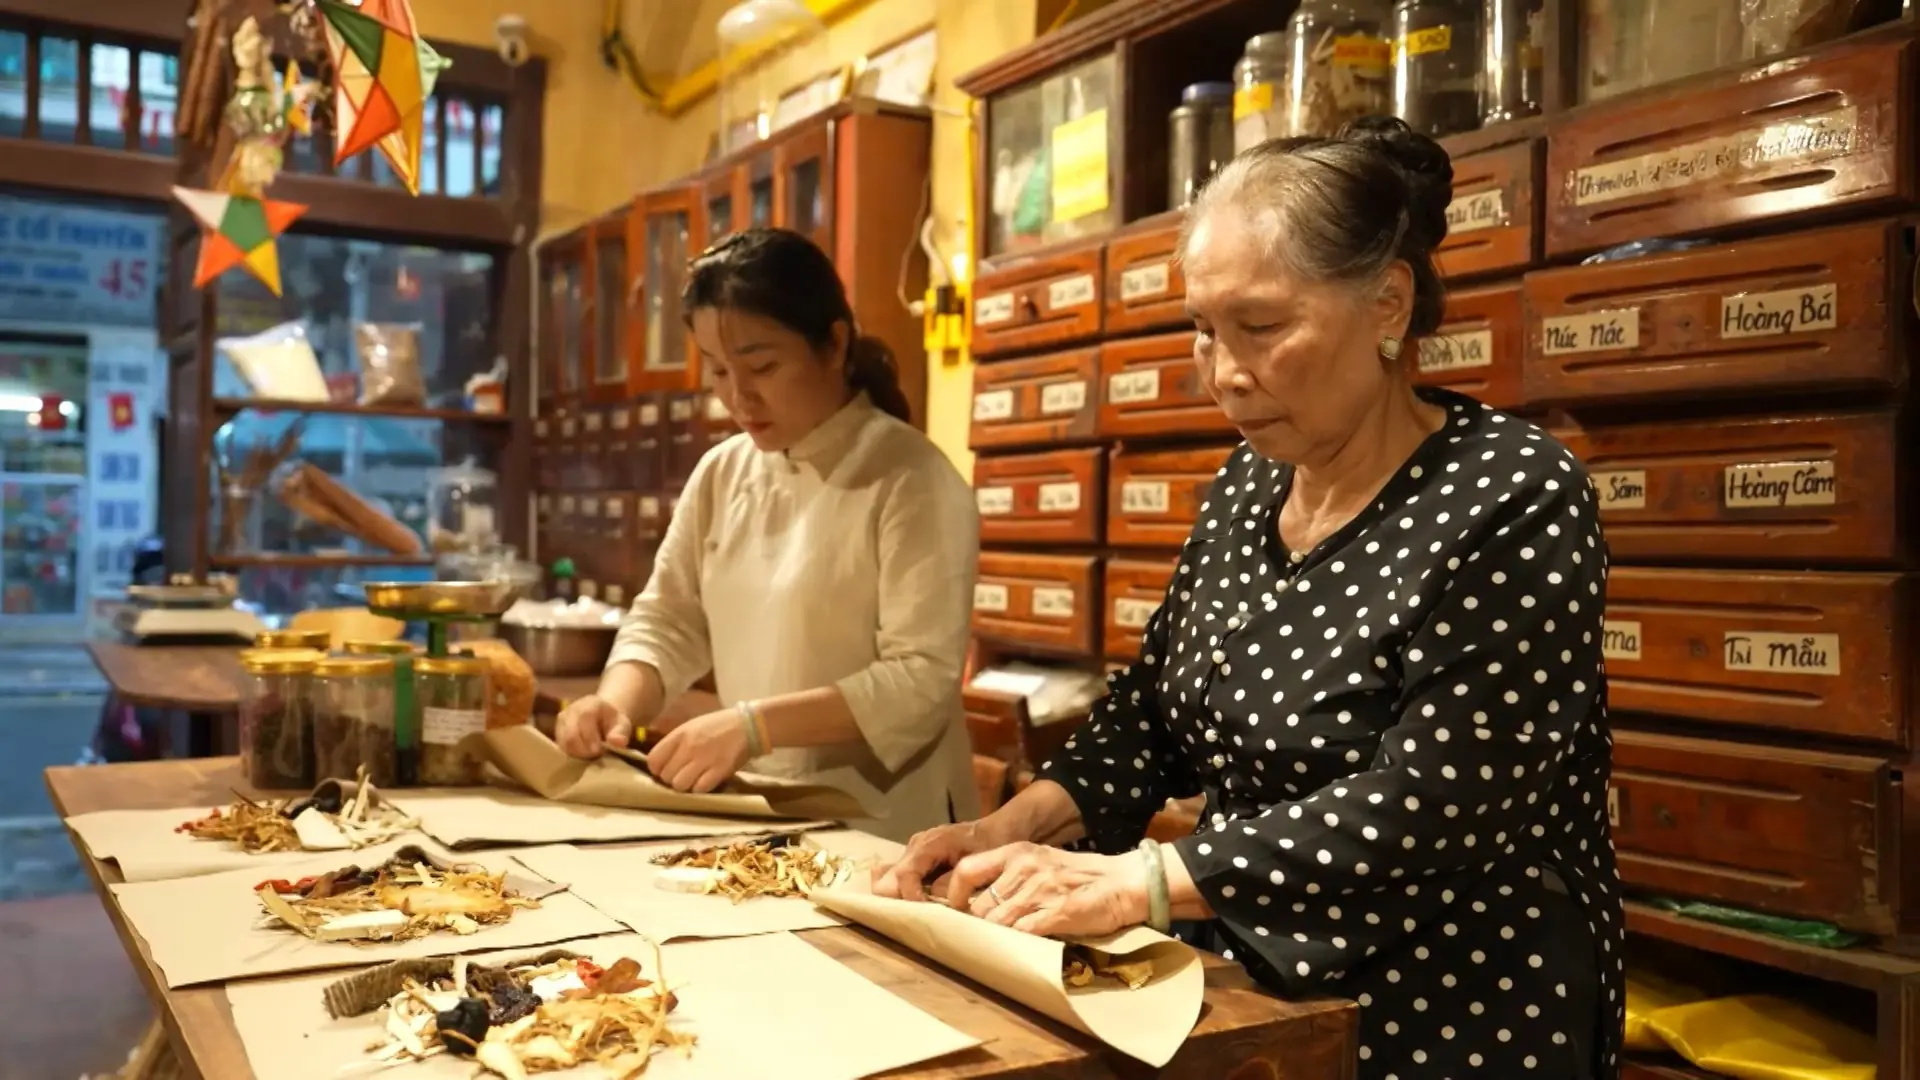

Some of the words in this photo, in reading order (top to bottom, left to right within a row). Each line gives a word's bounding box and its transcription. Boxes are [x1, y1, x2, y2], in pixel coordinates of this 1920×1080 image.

[1725, 301, 1794, 334] Hoàng
[1800, 292, 1832, 325] Bá
[1729, 470, 1789, 506] Hoàng
